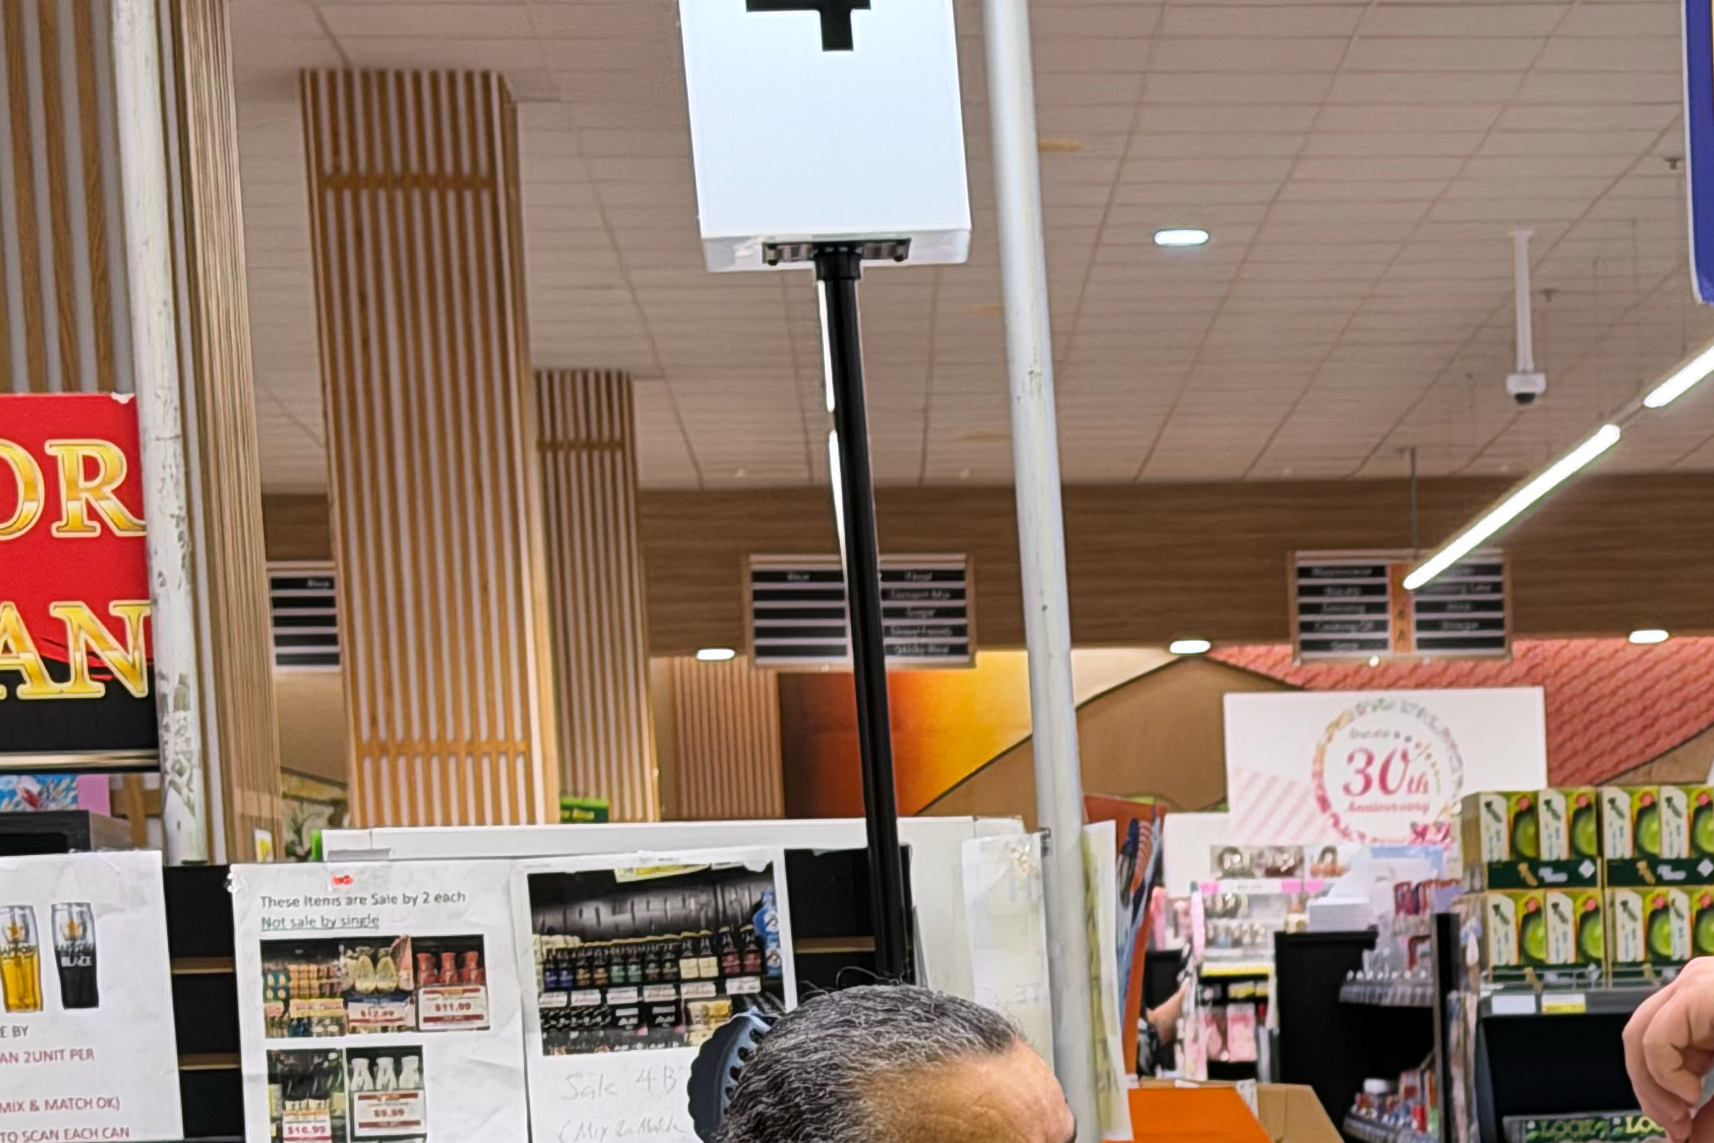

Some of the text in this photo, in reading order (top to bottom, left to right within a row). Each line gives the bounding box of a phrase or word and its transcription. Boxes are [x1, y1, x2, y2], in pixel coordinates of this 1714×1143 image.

[1342, 747, 1429, 797] 30th
[260, 895, 300, 908] These
[344, 896, 368, 907] are
[370, 893, 398, 906] Sale
[402, 893, 419, 908] by
[422, 891, 431, 905] 2
[434, 891, 466, 903] each
[261, 913, 380, 930] Not sale by single
[12, 1025, 29, 1038] BY
[24, 1049, 65, 1064] 2UNIT
[69, 1048, 95, 1061] PER
[635, 1069, 657, 1090] 4
[44, 1097, 93, 1111] MATCH
[96, 1096, 120, 1112] OK)
[0, 1126, 130, 1143] TO SCAN EACH CAN
